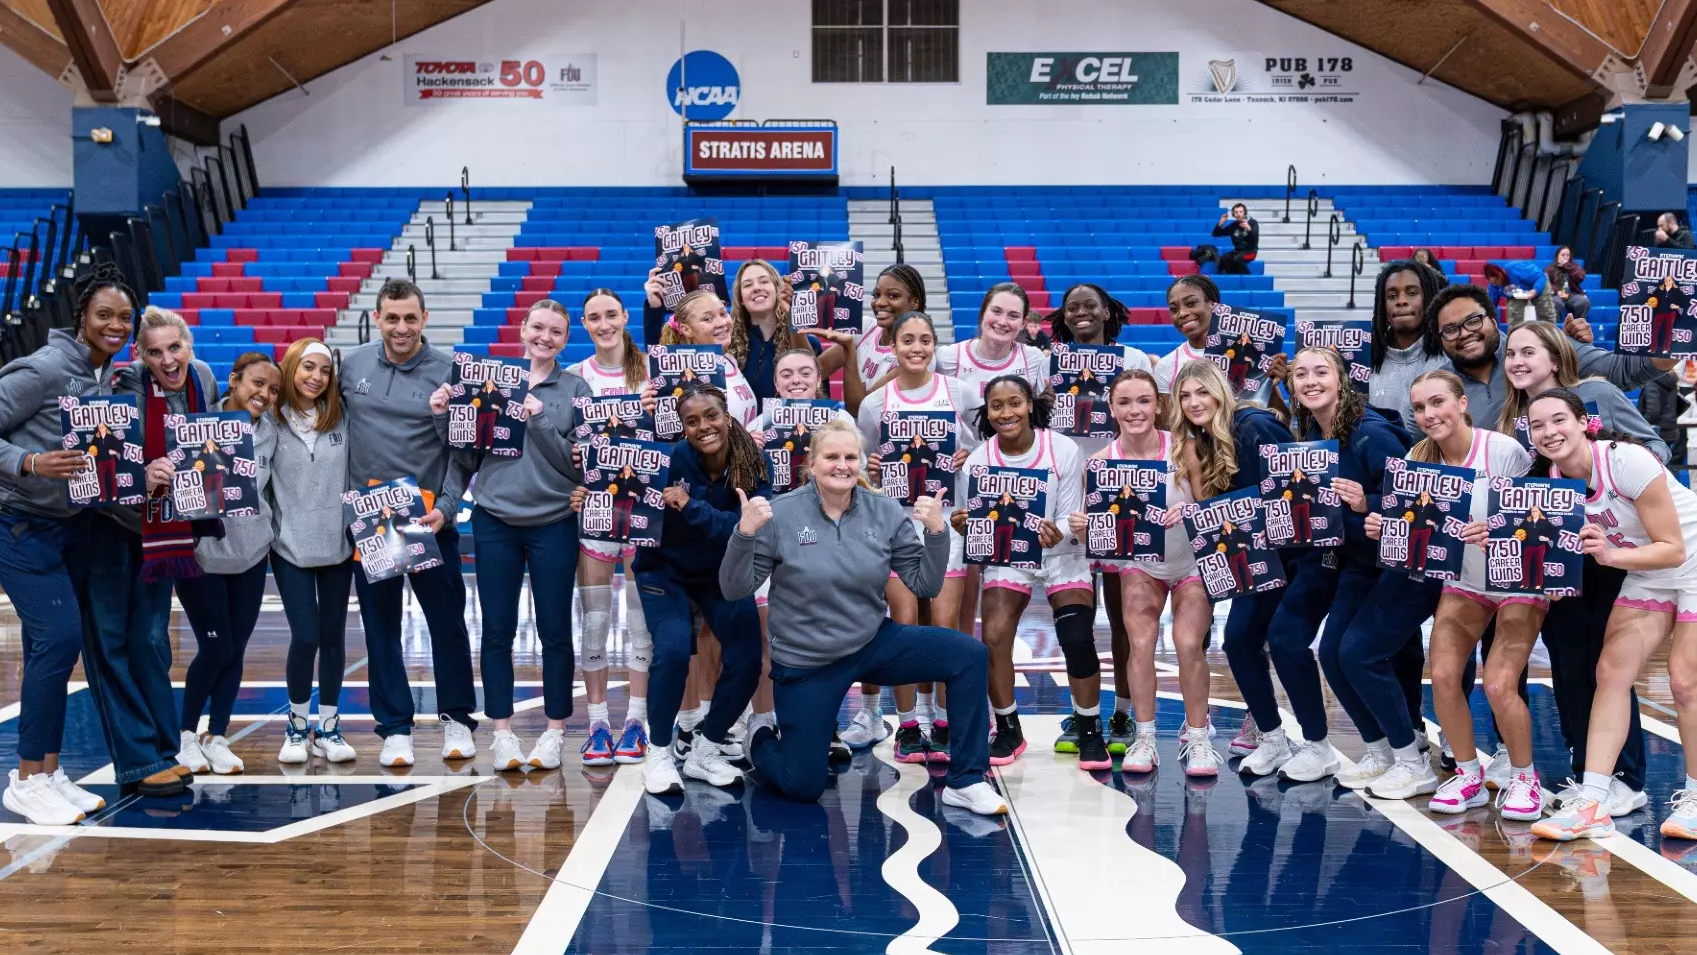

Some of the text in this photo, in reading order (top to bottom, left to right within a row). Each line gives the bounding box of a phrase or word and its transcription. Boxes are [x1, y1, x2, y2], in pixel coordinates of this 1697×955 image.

[415, 61, 476, 74] TOYOTA
[1265, 57, 1353, 72] PUB 178
[416, 77, 494, 86] Hackensack
[500, 60, 545, 87] 50
[675, 86, 738, 105] NCAA
[700, 141, 824, 159] STRATIS ARENA
[662, 225, 712, 251] GAITLEY
[705, 258, 724, 274] 750
[799, 249, 855, 267] GAITLEY
[1636, 258, 1697, 281] GAITLE
[664, 271, 681, 288] 50
[665, 285, 683, 296] AREER
[791, 290, 816, 306] 750
[844, 282, 864, 300] 750
[793, 306, 816, 314] CAREER
[1622, 305, 1652, 324] 750
[793, 313, 818, 325] WINS
[1219, 314, 1277, 339] GAITLEY
[1621, 324, 1650, 333] CAREER
[1672, 329, 1692, 341] 750
[1305, 329, 1362, 347] GAITLEY
[1621, 332, 1651, 346] WINS
[659, 352, 716, 372] GAITLEY
[1060, 353, 1115, 371] GAITLEY
[462, 363, 521, 384] GAITLEY
[1350, 363, 1371, 383] 750
[653, 396, 679, 414] 750
[1057, 394, 1074, 409] 50
[70, 405, 131, 428] GAITLEY
[450, 405, 476, 422] 750
[583, 400, 643, 421] GAITLEY
[773, 408, 830, 425] GAITLEY
[1091, 412, 1106, 422] 750
[450, 421, 475, 430] CAREER
[657, 420, 683, 435] WINS
[890, 420, 946, 438] GAITLEY
[1513, 416, 1527, 431] 75
[177, 420, 243, 445] GAITLEY
[450, 429, 475, 441] WINS
[494, 427, 511, 439] 750
[123, 443, 144, 463] 750
[598, 446, 661, 471] GAITLEY
[1268, 449, 1329, 474] GAITLEY
[233, 457, 256, 476] 750
[774, 465, 789, 474] REER
[881, 462, 906, 479] 750
[115, 474, 132, 486] 750
[171, 469, 201, 489] 750
[883, 478, 907, 487] CAREER
[978, 475, 1038, 496] GAITLEY
[1098, 469, 1157, 488] GAITLEY
[1394, 470, 1462, 498] GAITLEY
[72, 481, 100, 499] WINS
[174, 487, 203, 499] CAREER
[223, 487, 242, 499] 750
[644, 487, 666, 510] 750
[1320, 487, 1340, 507] 750
[176, 495, 206, 511] WINS
[353, 485, 413, 516] GAITLEY
[586, 491, 612, 510] 750
[1501, 488, 1574, 510] GAITLEY
[147, 497, 173, 523] FD
[585, 509, 611, 519] CAREER
[1145, 505, 1166, 525] 750
[1192, 497, 1256, 532] GAITLEY
[1264, 499, 1290, 518] 750
[585, 517, 612, 530] WINS
[631, 515, 648, 528] 750
[968, 518, 993, 535] 750
[1088, 513, 1114, 529] 750
[1266, 516, 1292, 527] CAREER
[1310, 517, 1327, 529] 750
[1381, 518, 1409, 538] 750
[968, 535, 993, 544] CAREER
[1090, 529, 1115, 538] CAREER
[1134, 533, 1151, 544] 750
[1268, 524, 1294, 540] WINS
[357, 534, 386, 556] 750
[968, 543, 993, 555] WINS
[1012, 540, 1028, 552] 750
[1090, 537, 1116, 550] WINS
[1380, 536, 1407, 548] CAREER
[1489, 539, 1520, 558] 750
[1558, 530, 1584, 554] 750
[1380, 545, 1408, 560] WINS
[1428, 546, 1447, 560] 750
[366, 555, 394, 575] WINS
[1198, 552, 1228, 575] 750
[1248, 561, 1268, 576] 750
[1490, 558, 1520, 568] CAREER
[1544, 562, 1564, 576] 750
[1204, 568, 1231, 583] CAREER
[1490, 567, 1522, 582] WINS
[1207, 575, 1236, 594] WINS
